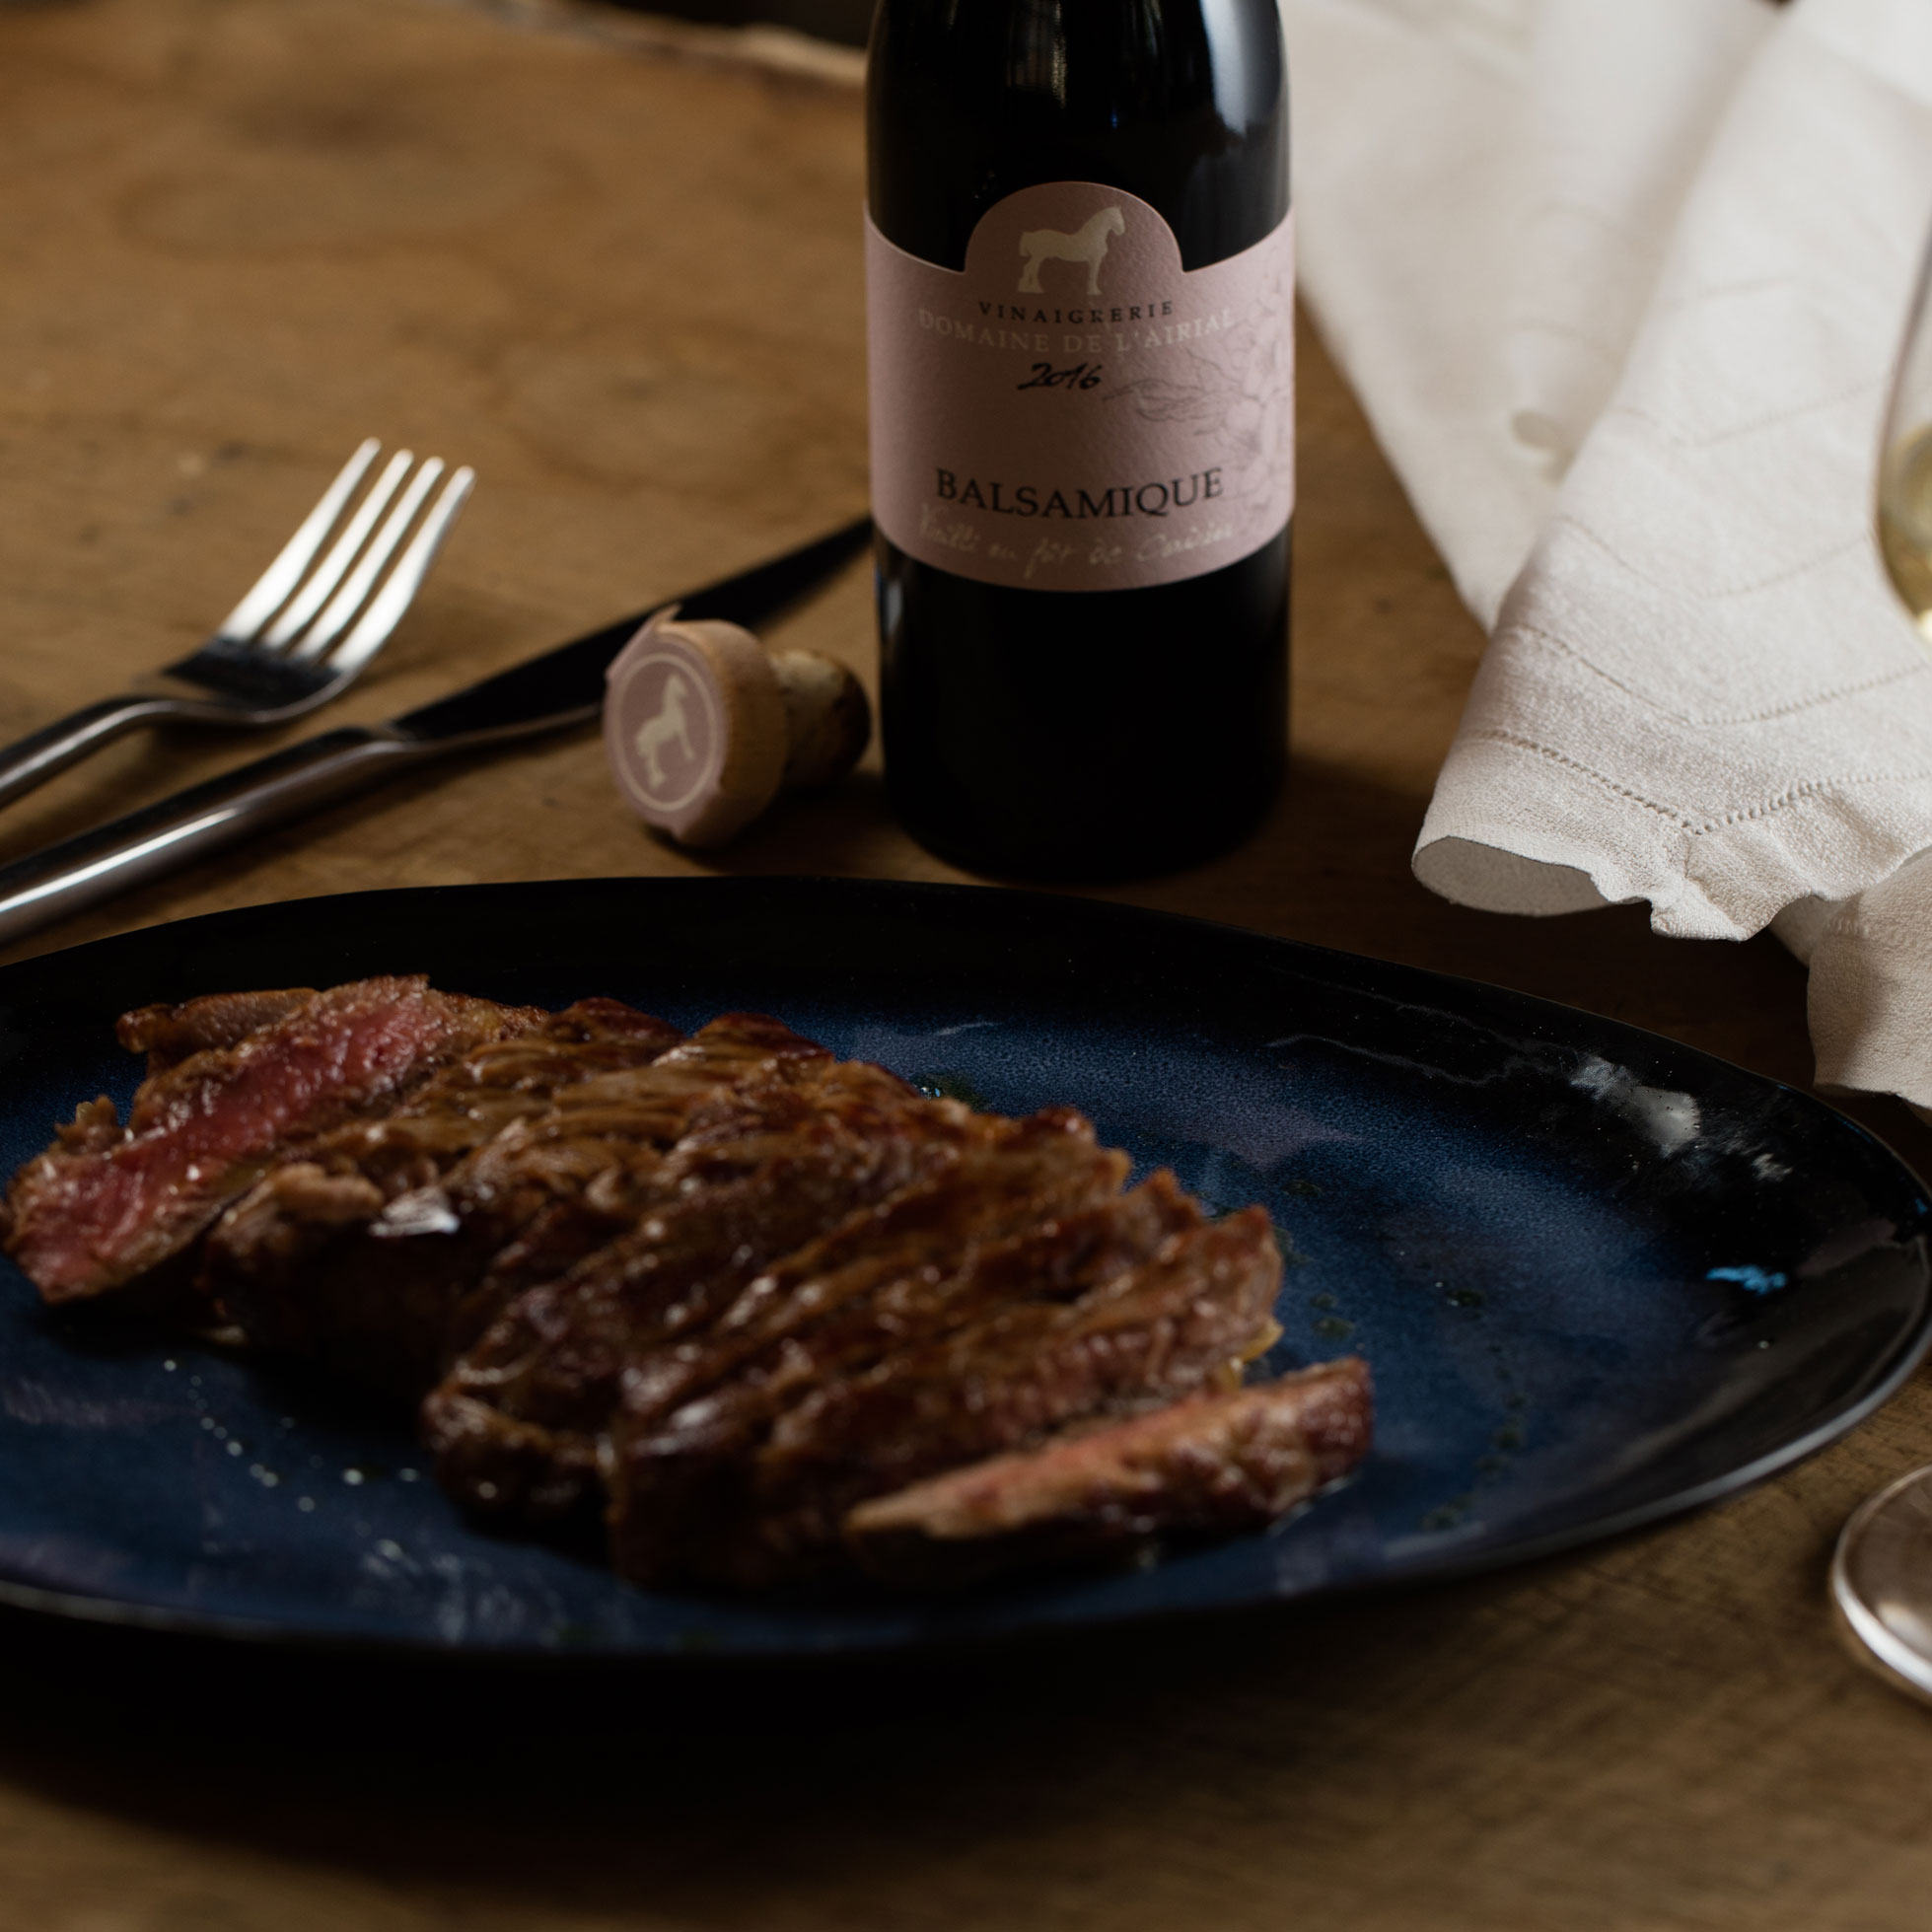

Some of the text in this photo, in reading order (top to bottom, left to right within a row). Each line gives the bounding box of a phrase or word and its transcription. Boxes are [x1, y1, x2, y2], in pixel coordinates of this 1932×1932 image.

[978, 300, 1174, 324] VINAIGRERIE
[918, 308, 1233, 354] DOMAINE DE L'AIRIAL
[1015, 361, 1103, 391] 2016
[936, 466, 1224, 519] BALSAMIQUE
[1089, 536, 1122, 565] de
